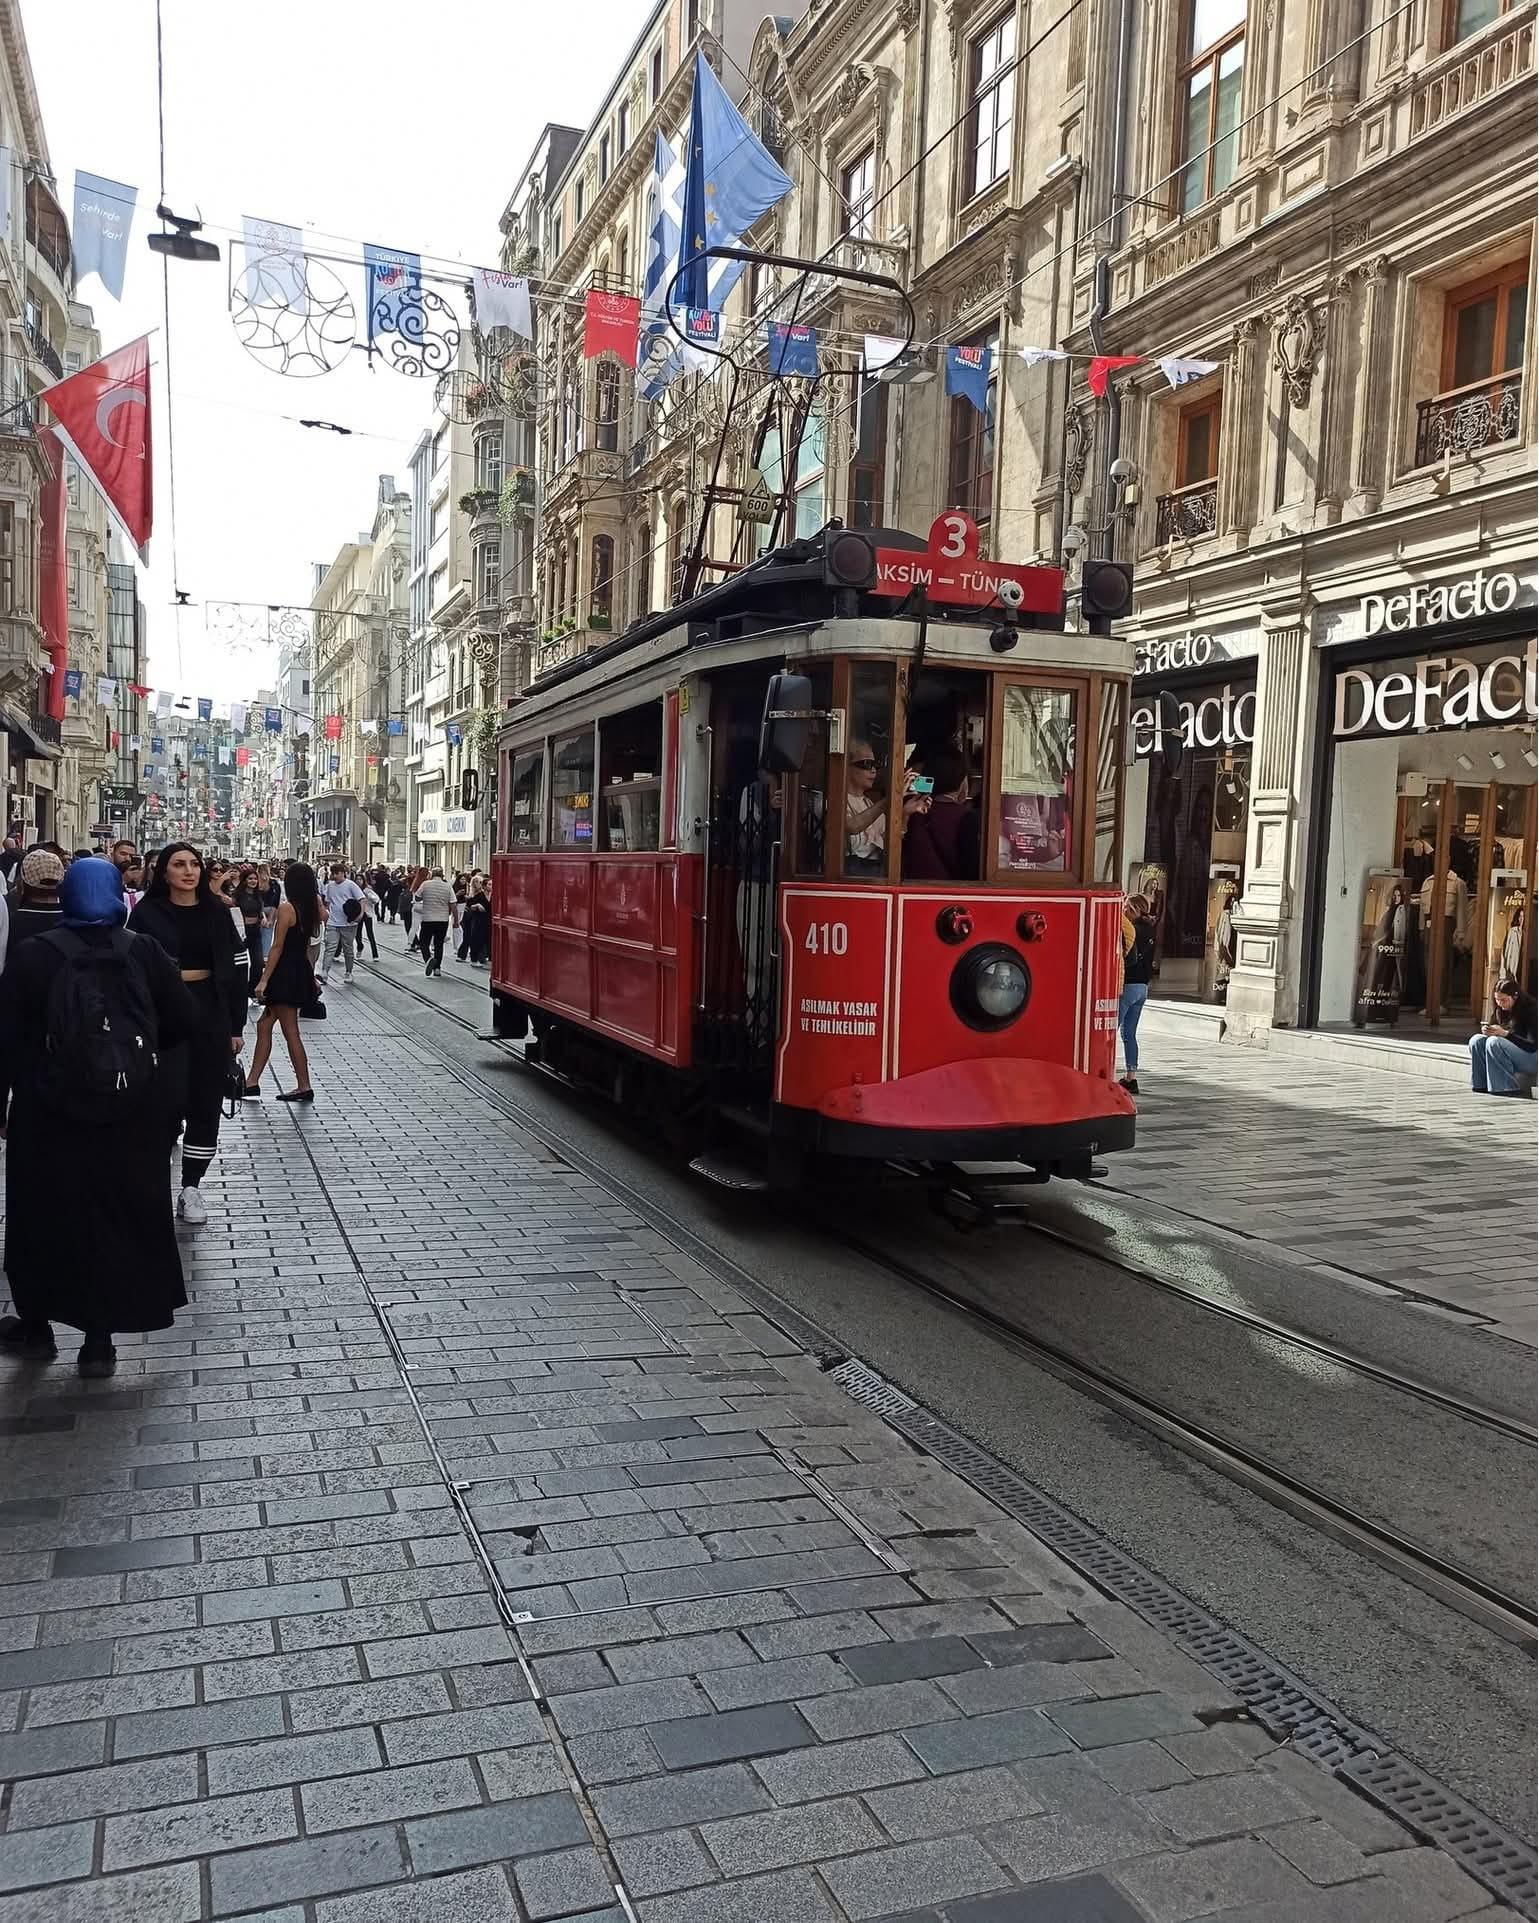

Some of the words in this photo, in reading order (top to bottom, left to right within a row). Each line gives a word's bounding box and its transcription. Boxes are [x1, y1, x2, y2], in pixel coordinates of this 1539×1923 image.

[501, 279, 523, 289] Var!
[791, 332, 810, 342] Var!
[747, 499, 769, 512] 600
[940, 516, 968, 558] 3
[1360, 568, 1519, 637] DeFacto
[805, 922, 848, 956] 410
[843, 1001, 878, 1017] YASAK
[800, 1017, 810, 1032] VE
